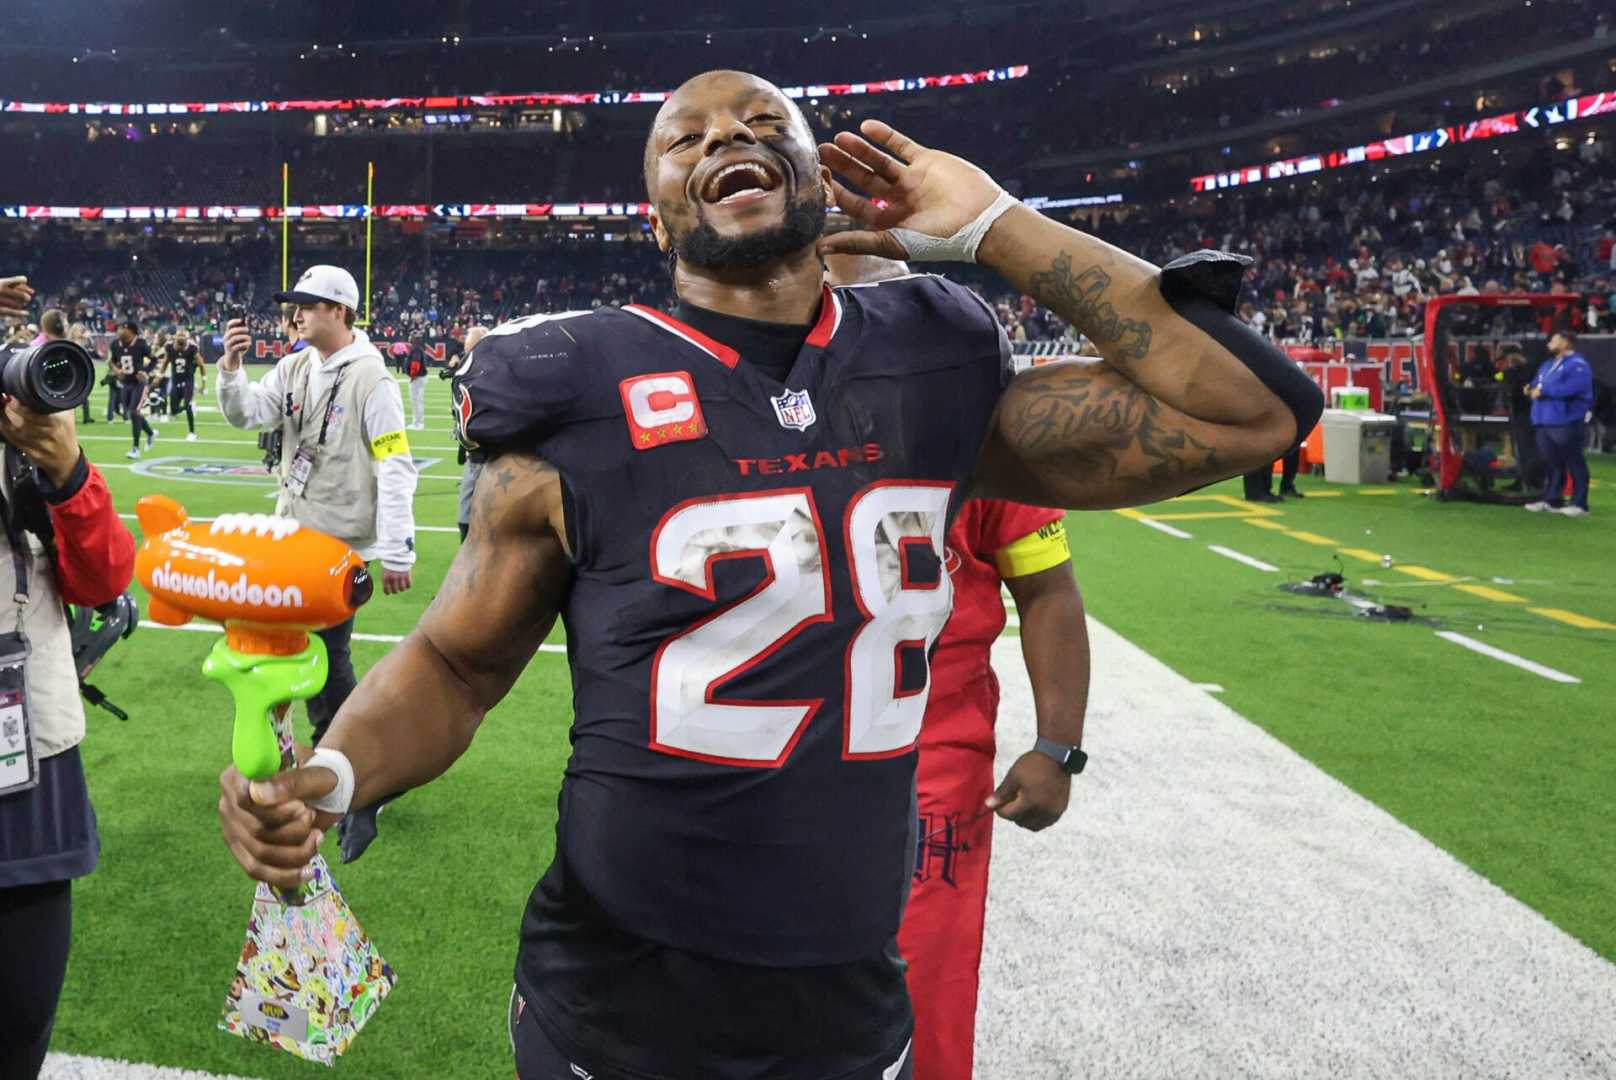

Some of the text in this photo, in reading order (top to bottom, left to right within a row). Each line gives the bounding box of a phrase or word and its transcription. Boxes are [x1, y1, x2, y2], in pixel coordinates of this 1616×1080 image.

[120, 355, 134, 375] 8
[175, 358, 186, 373] 2
[628, 376, 695, 429] C
[734, 442, 883, 477] TEXANS
[151, 560, 303, 608] nickelodeon
[648, 479, 957, 768] 28
